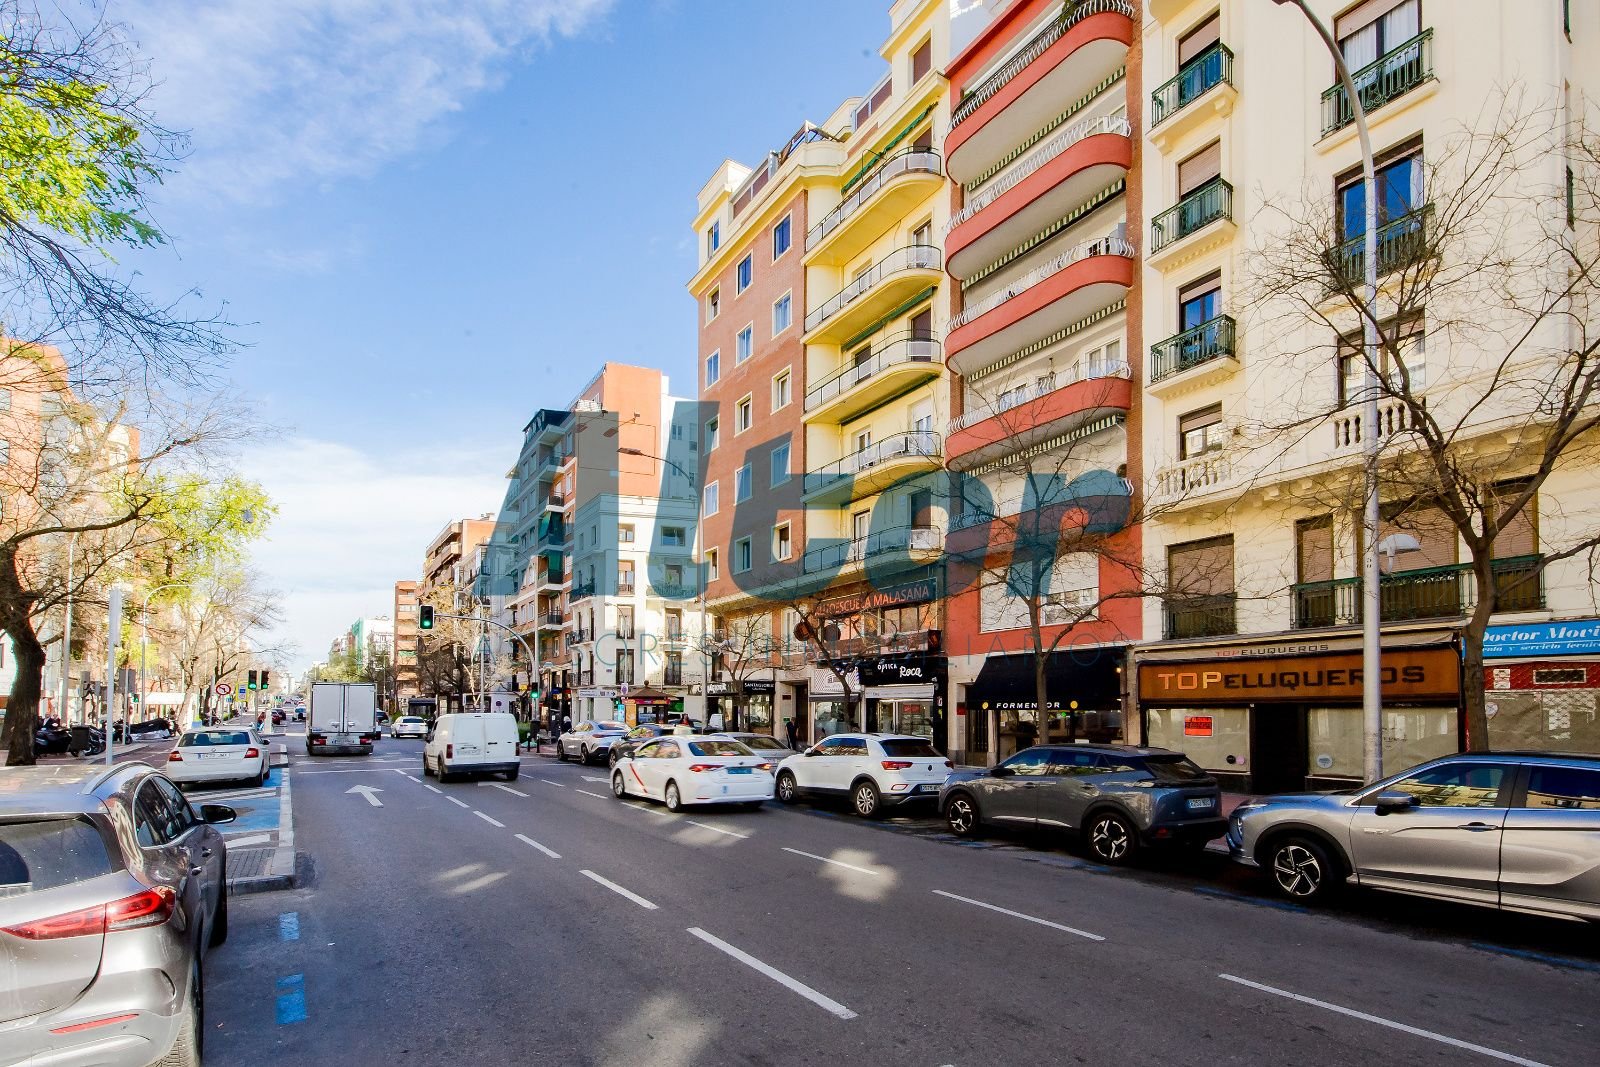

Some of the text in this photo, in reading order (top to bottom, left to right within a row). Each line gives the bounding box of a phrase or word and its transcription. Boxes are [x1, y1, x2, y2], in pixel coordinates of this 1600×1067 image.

[873, 585, 929, 607] MALASAÑA
[899, 665, 923, 678] Roca
[996, 701, 1061, 709] FORMENOR
